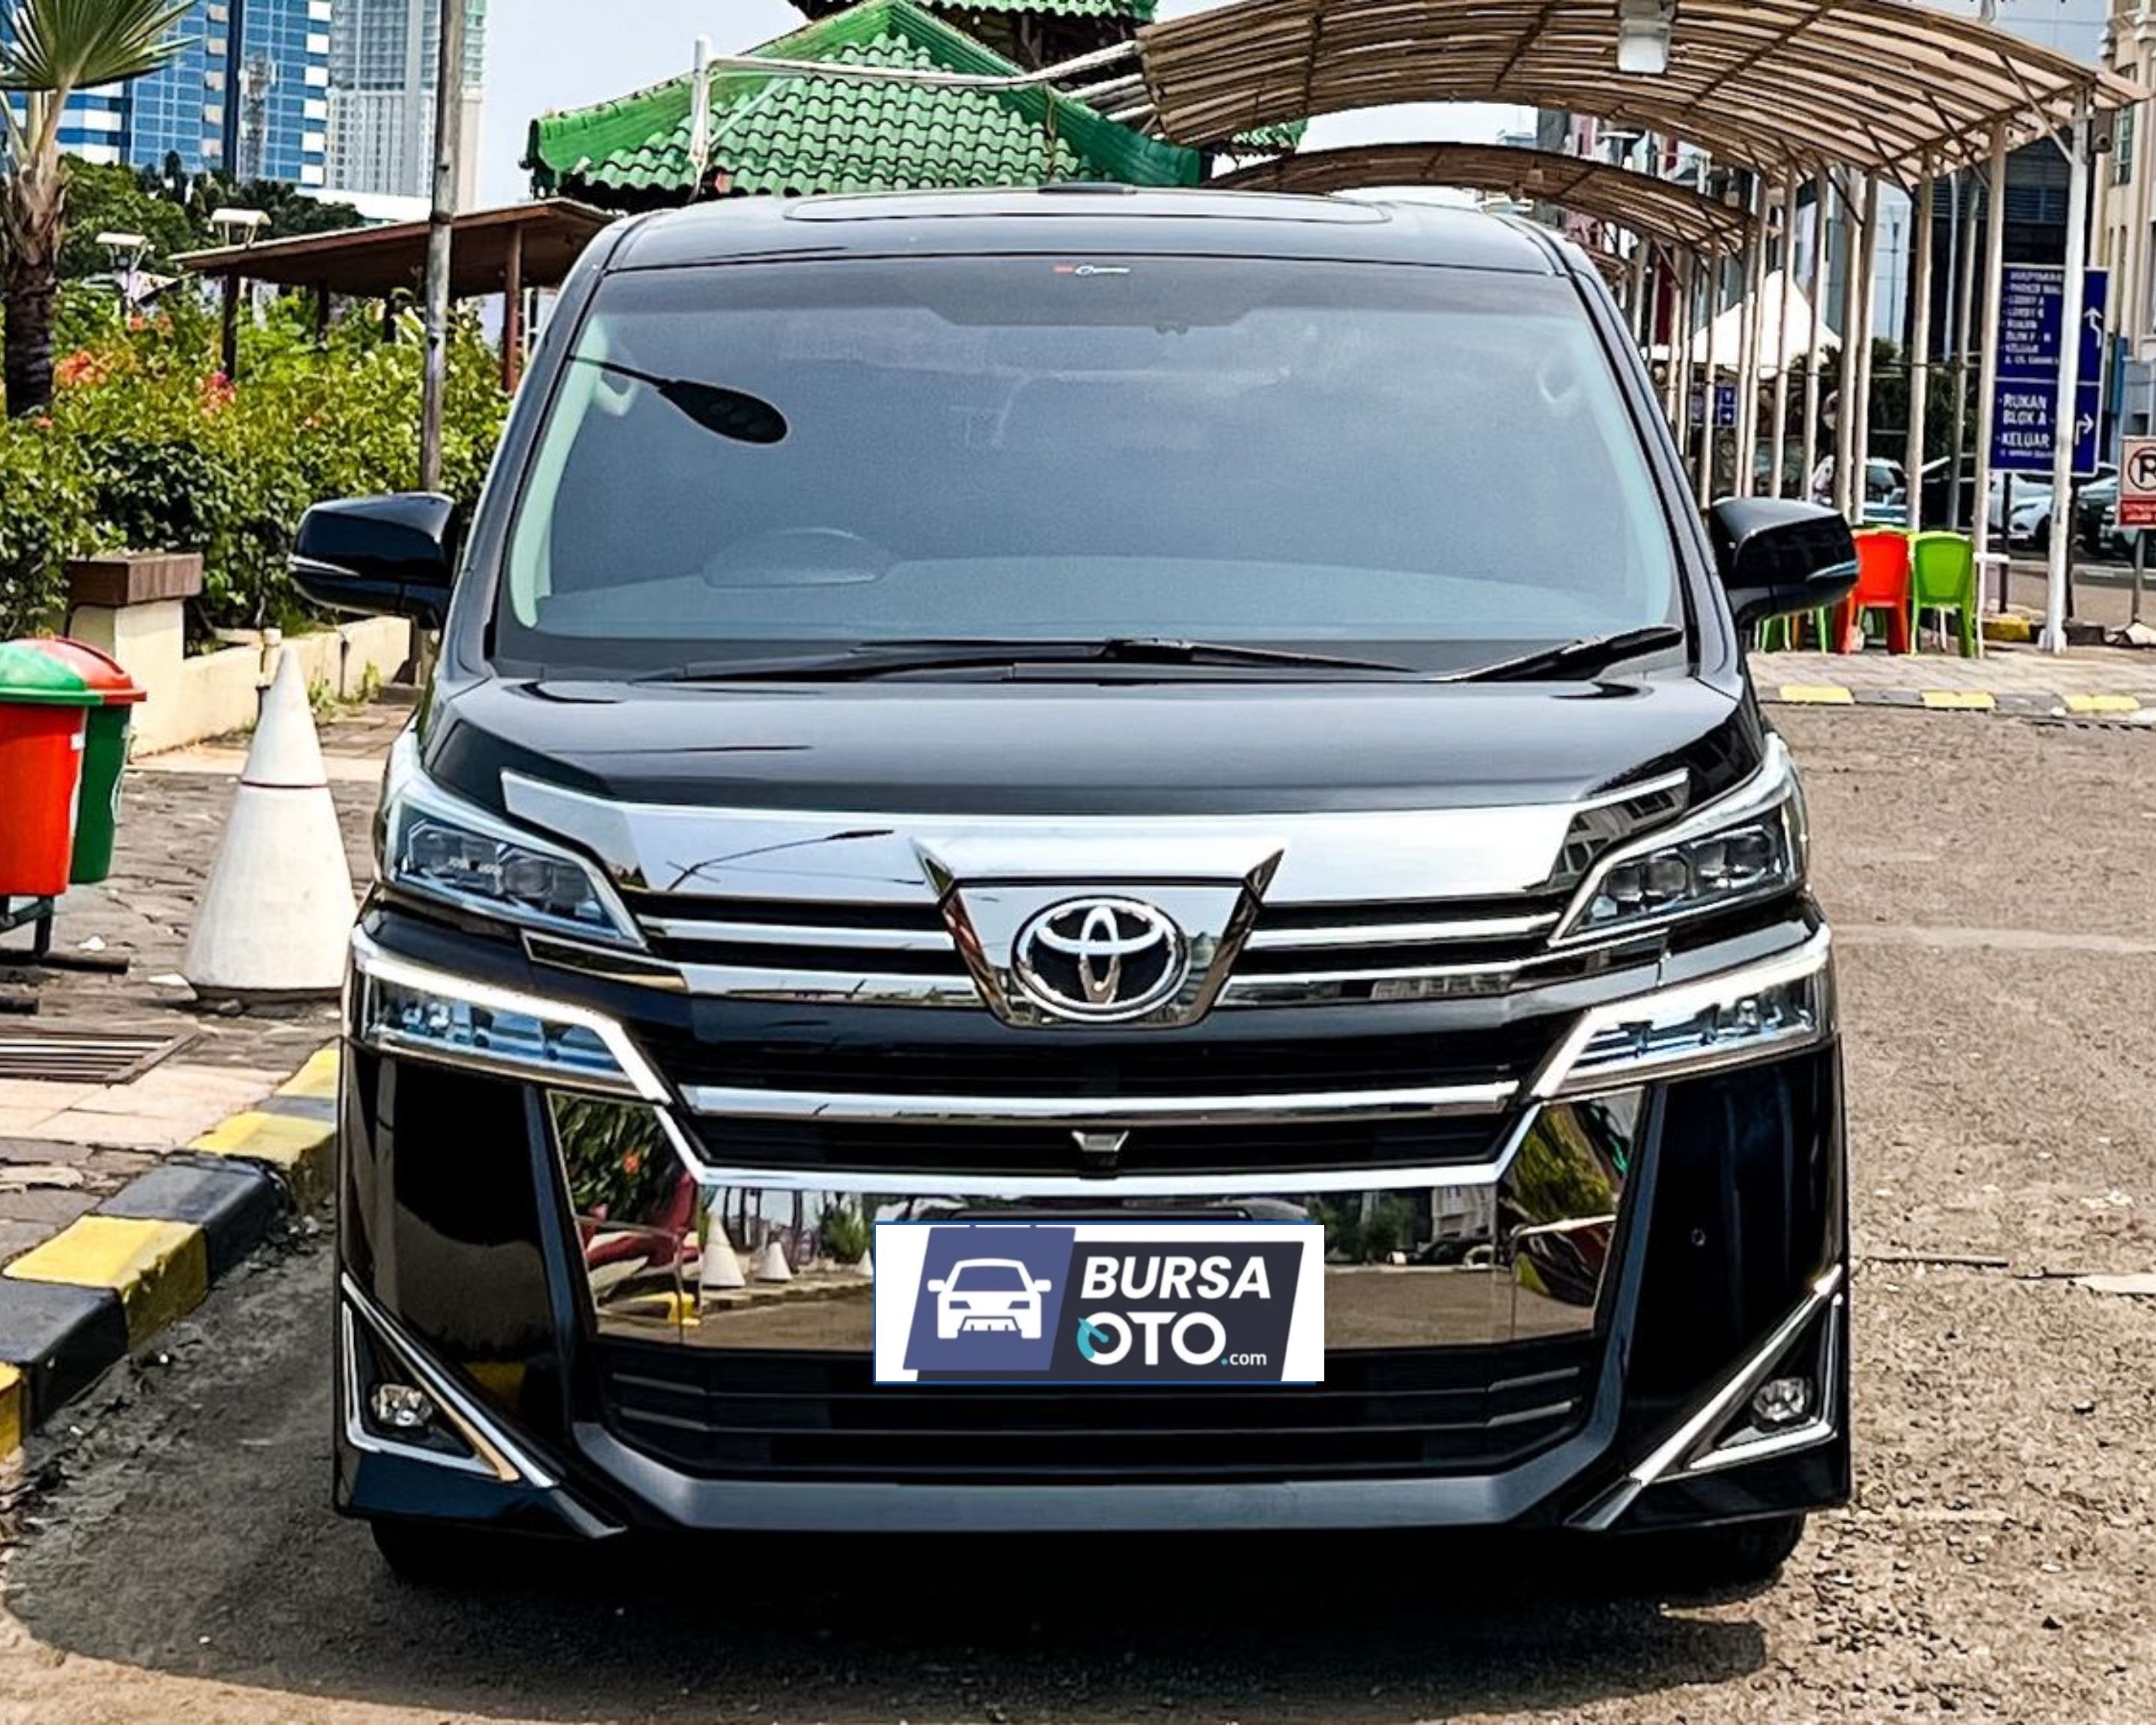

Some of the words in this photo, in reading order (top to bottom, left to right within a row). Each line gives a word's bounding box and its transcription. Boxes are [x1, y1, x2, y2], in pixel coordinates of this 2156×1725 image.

[2003, 393, 2047, 410] RUKAN
[2003, 410, 2035, 425] BLOK
[2037, 411, 2047, 425] A
[2002, 433, 2050, 448] KELUAR
